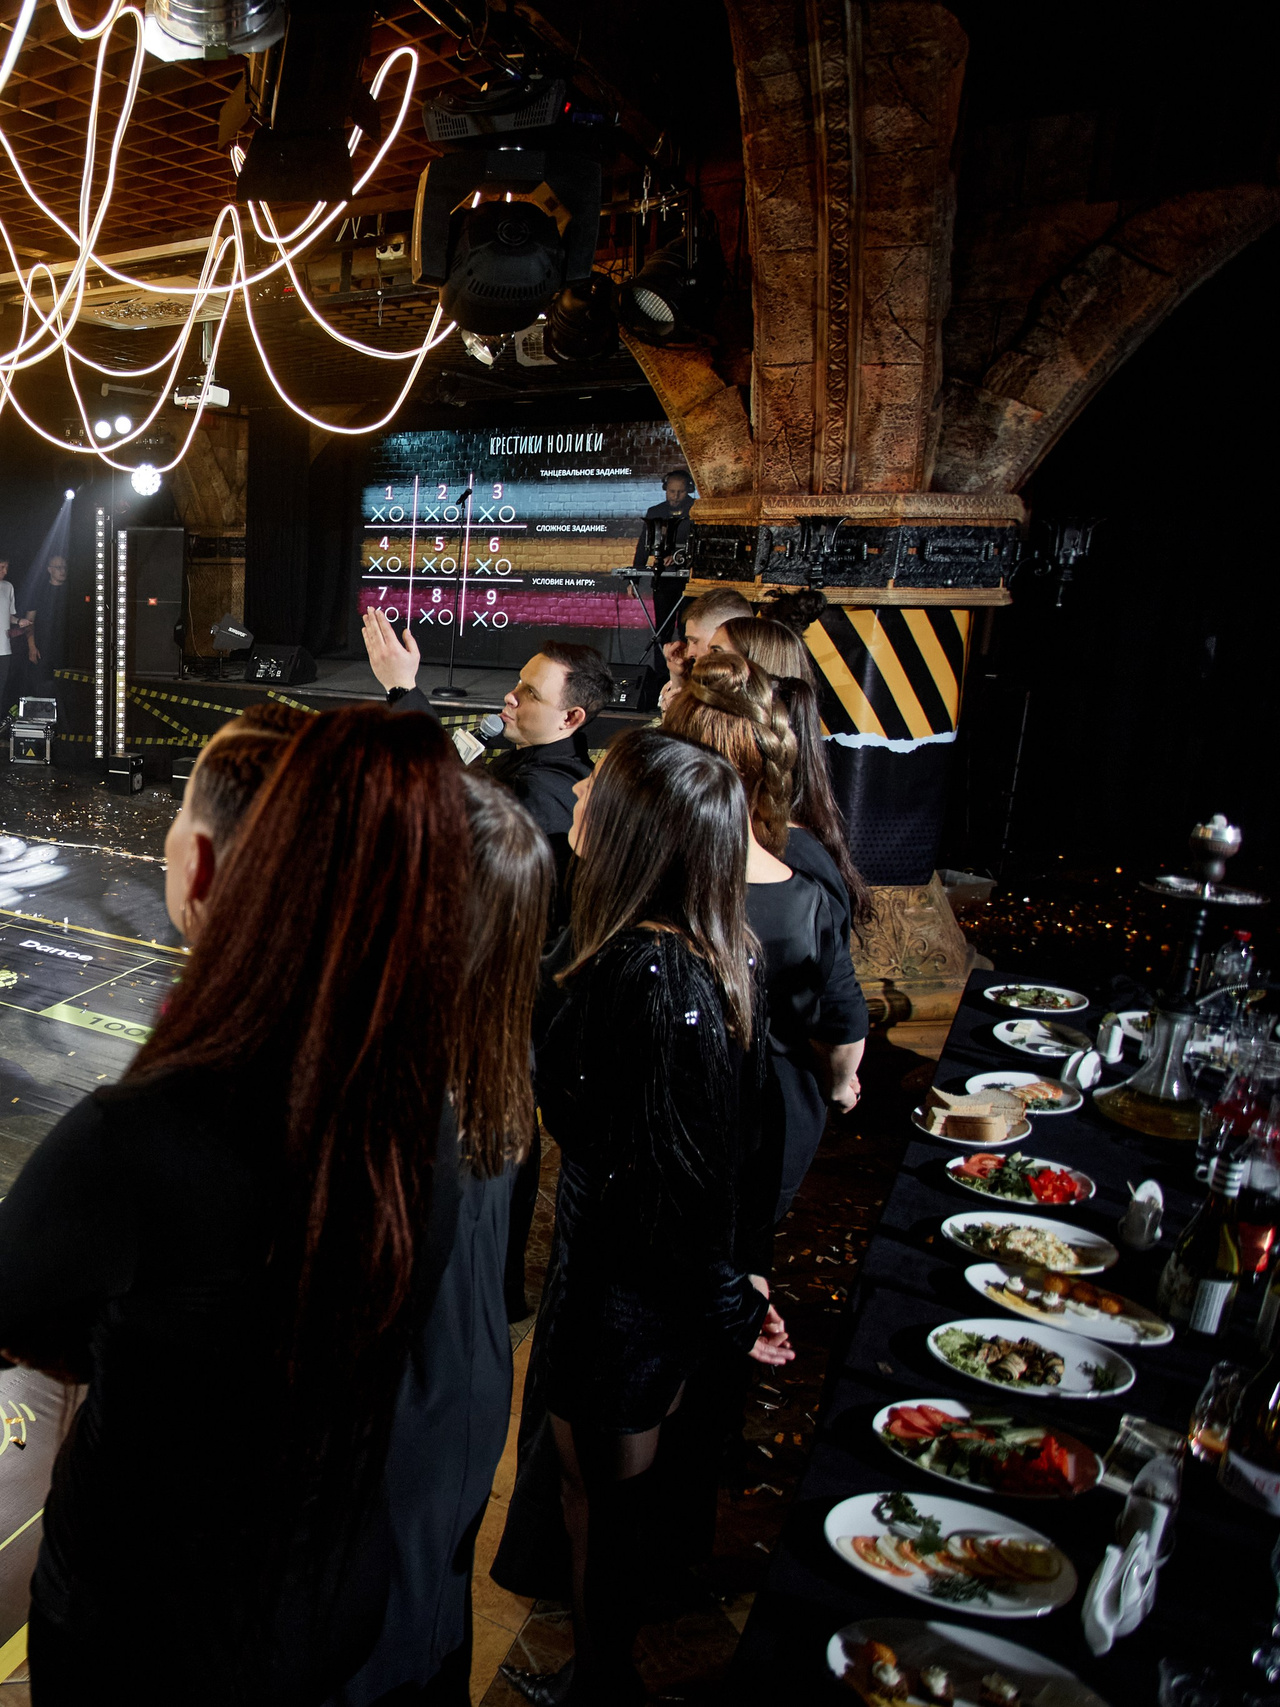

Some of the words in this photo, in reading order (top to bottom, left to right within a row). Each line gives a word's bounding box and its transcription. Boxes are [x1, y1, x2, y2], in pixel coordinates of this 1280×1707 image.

[489, 435, 543, 455] КРЕСТИКИ
[547, 432, 604, 454] НОЛИКИ
[540, 468, 595, 478] ТАНЦЕВАЛЬНОЕ
[595, 468, 632, 476] ЗАДАНИЕ:
[385, 485, 394, 500] 1
[438, 485, 447, 500] 2
[492, 484, 502, 499] 3
[572, 525, 607, 533] ЗАДАНИЕ:
[379, 536, 389, 551] 4
[434, 537, 444, 551] 5
[489, 537, 500, 553] 6
[532, 578, 564, 586] УСЛОВИЕ
[576, 579, 596, 587] ИГРУ:
[378, 586, 388, 601] 7
[432, 589, 442, 603] 8
[487, 590, 497, 606] 9
[19, 939, 94, 962] Dance
[89, 1017, 152, 1041] 100
